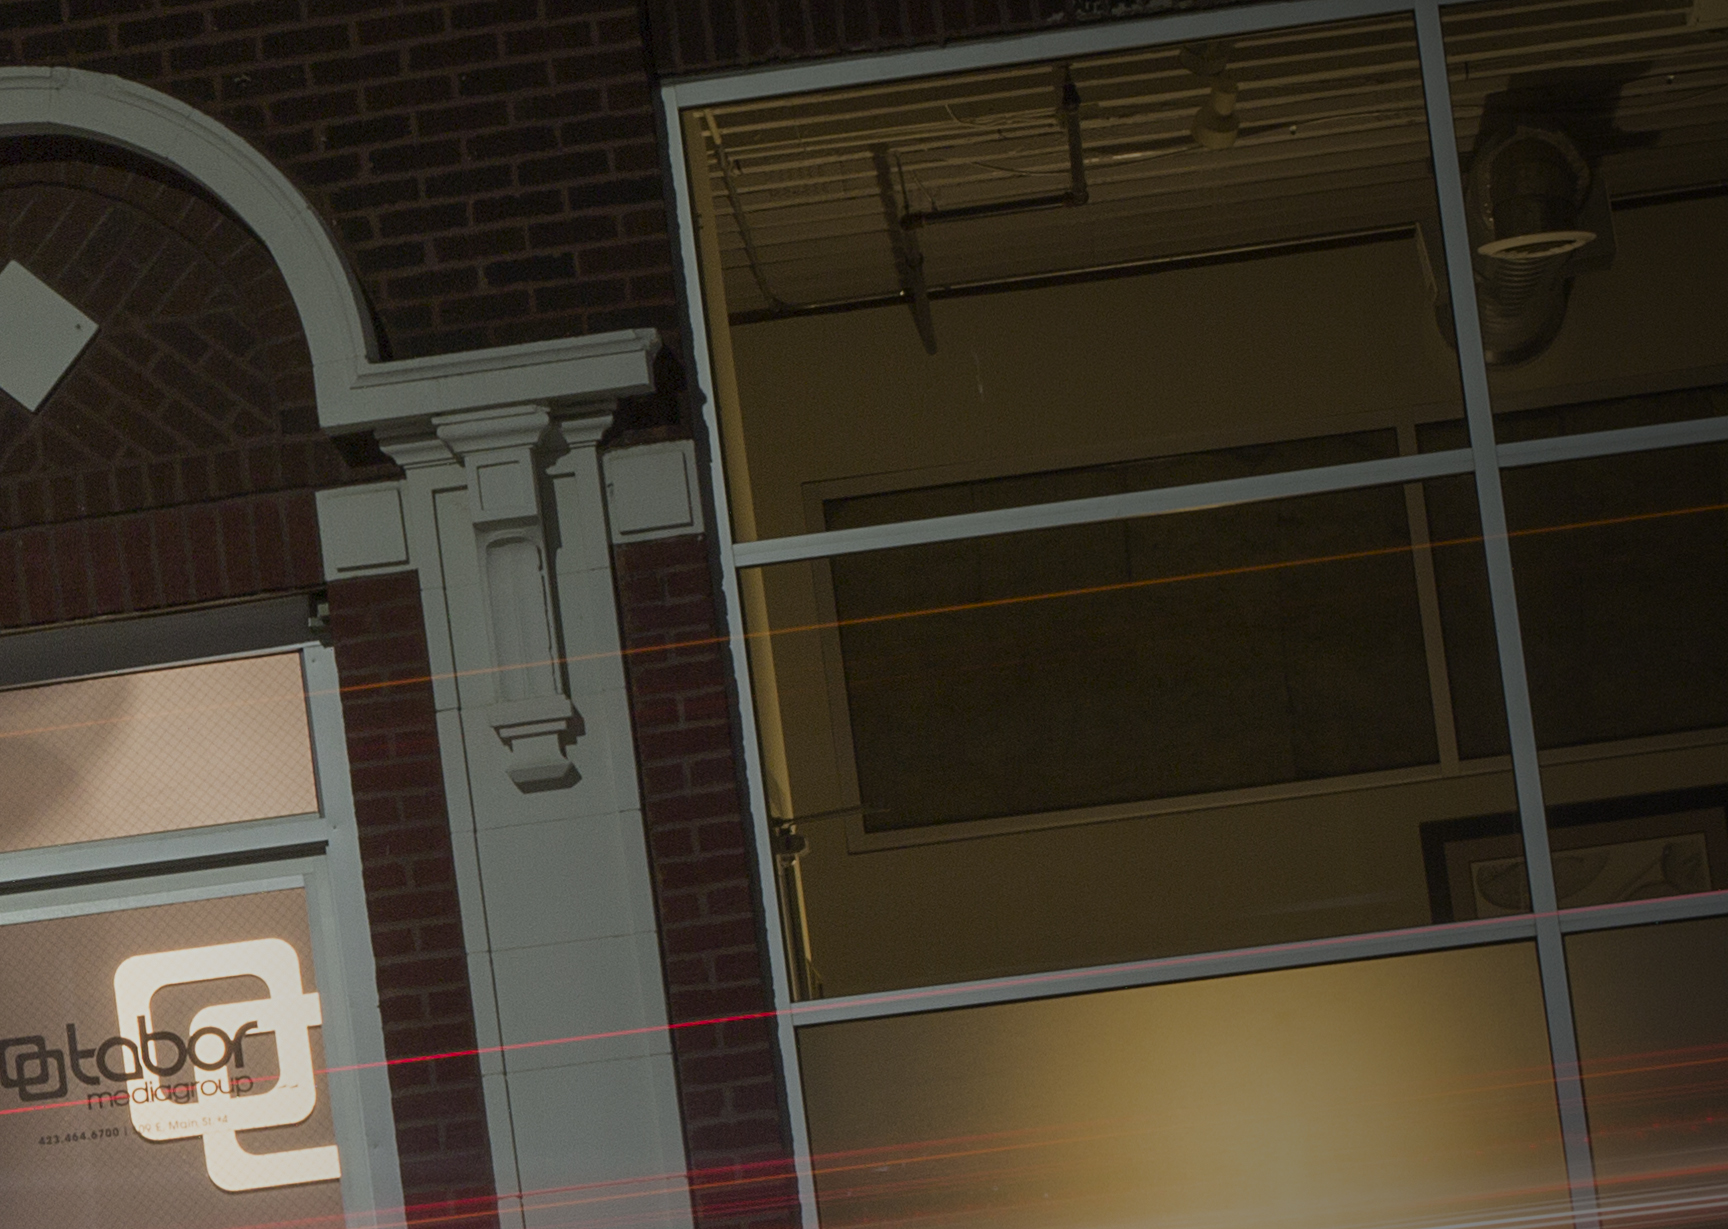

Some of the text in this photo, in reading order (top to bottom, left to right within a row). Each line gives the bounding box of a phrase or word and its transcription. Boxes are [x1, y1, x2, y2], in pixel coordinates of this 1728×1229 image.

[65, 1014, 258, 1086] tabor
[38, 1127, 120, 1146] 423.464.6700
[169, 1118, 198, 1131] Main
